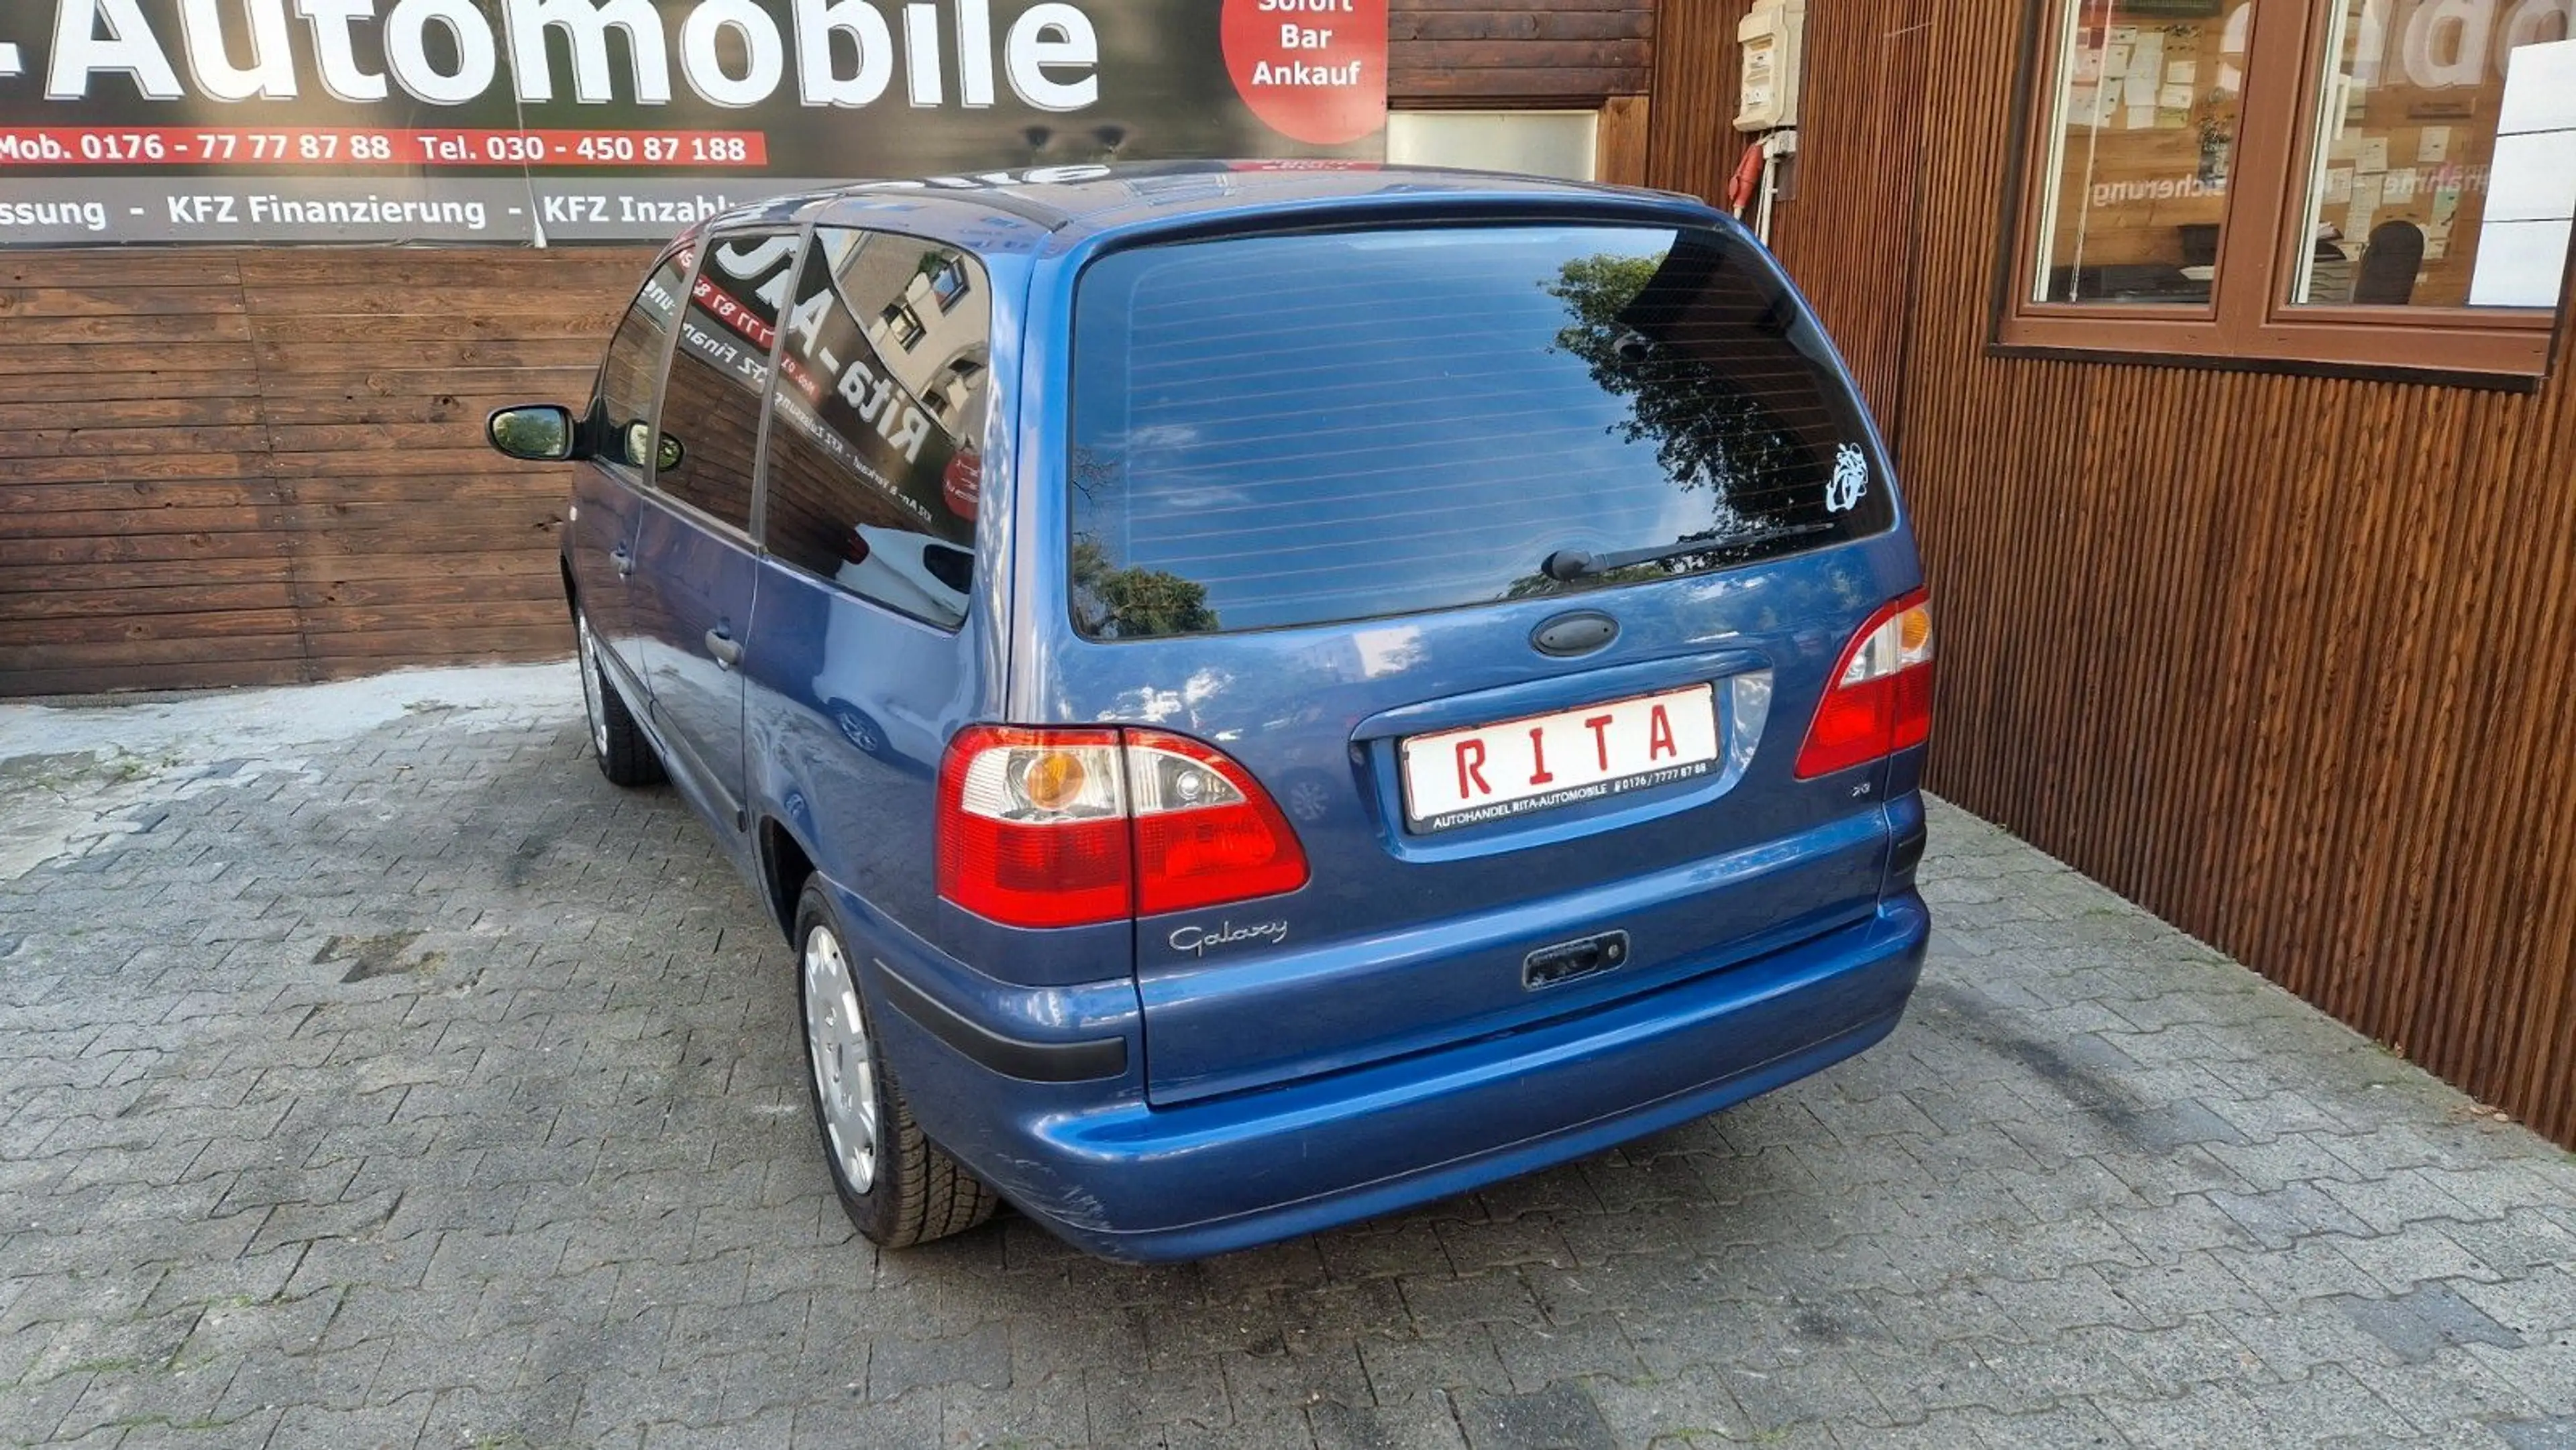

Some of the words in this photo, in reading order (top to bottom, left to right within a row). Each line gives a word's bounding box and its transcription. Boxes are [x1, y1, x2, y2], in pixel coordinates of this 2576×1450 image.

[1281, 24, 1332, 48] Bar
[1252, 60, 1361, 85] Ankauf
[0, 134, 72, 159] Mob.
[81, 135, 164, 159] 0176
[198, 135, 235, 158] 77
[248, 135, 287, 158] 77
[299, 135, 337, 158] 87
[351, 135, 390, 158] 88
[418, 137, 476, 159] Tel.
[486, 137, 544, 160] 030
[576, 137, 633, 160] 450
[644, 138, 679, 160] 87
[692, 138, 746, 160] 188
[0, 202, 107, 230] ssung
[167, 196, 238, 223] KFZ
[248, 195, 485, 229] Finanzierung
[543, 196, 608, 223] KFZ
[618, 195, 735, 222] Inzahl
[1455, 704, 1677, 799] RITA
[1433, 801, 1511, 830] AUTOHANDEL
[1169, 919, 1288, 957] Galaxy
